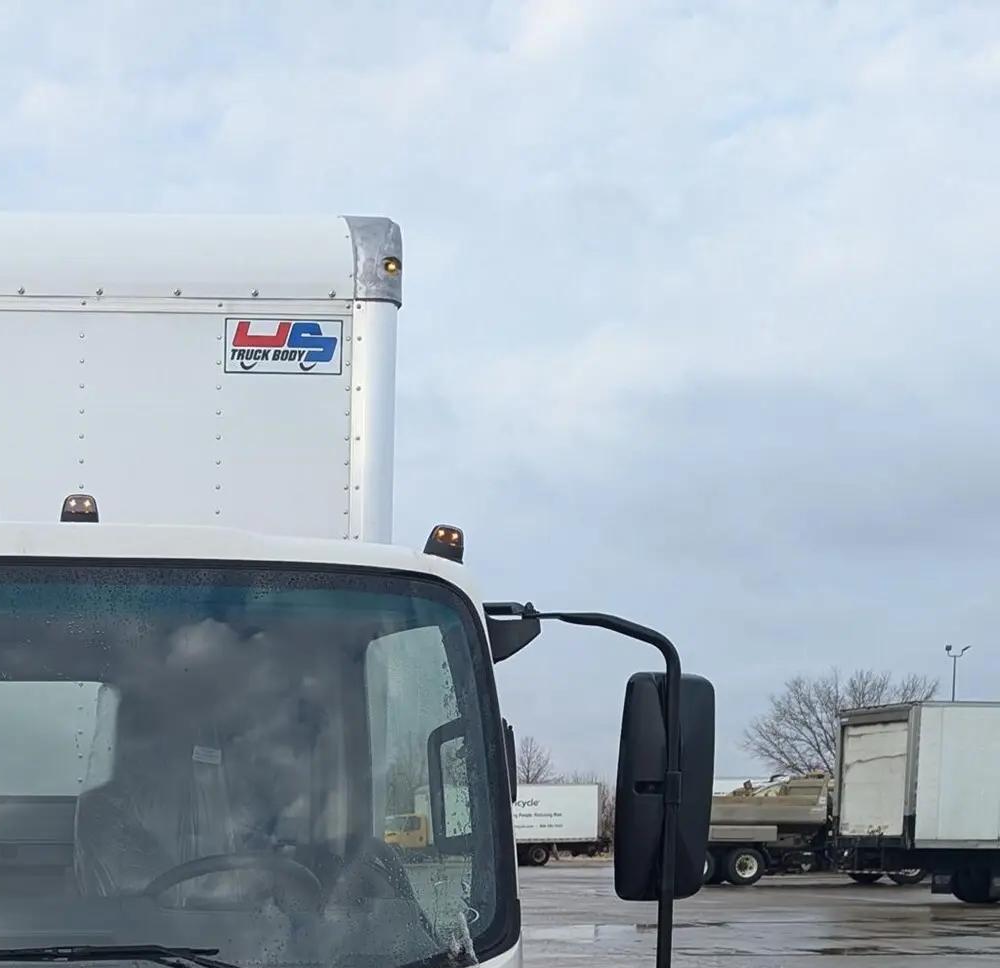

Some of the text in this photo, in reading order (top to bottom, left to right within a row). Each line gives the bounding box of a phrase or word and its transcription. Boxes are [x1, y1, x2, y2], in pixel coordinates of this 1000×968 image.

[230, 348, 305, 362] TRUCK BODY
[232, 321, 338, 362] US
